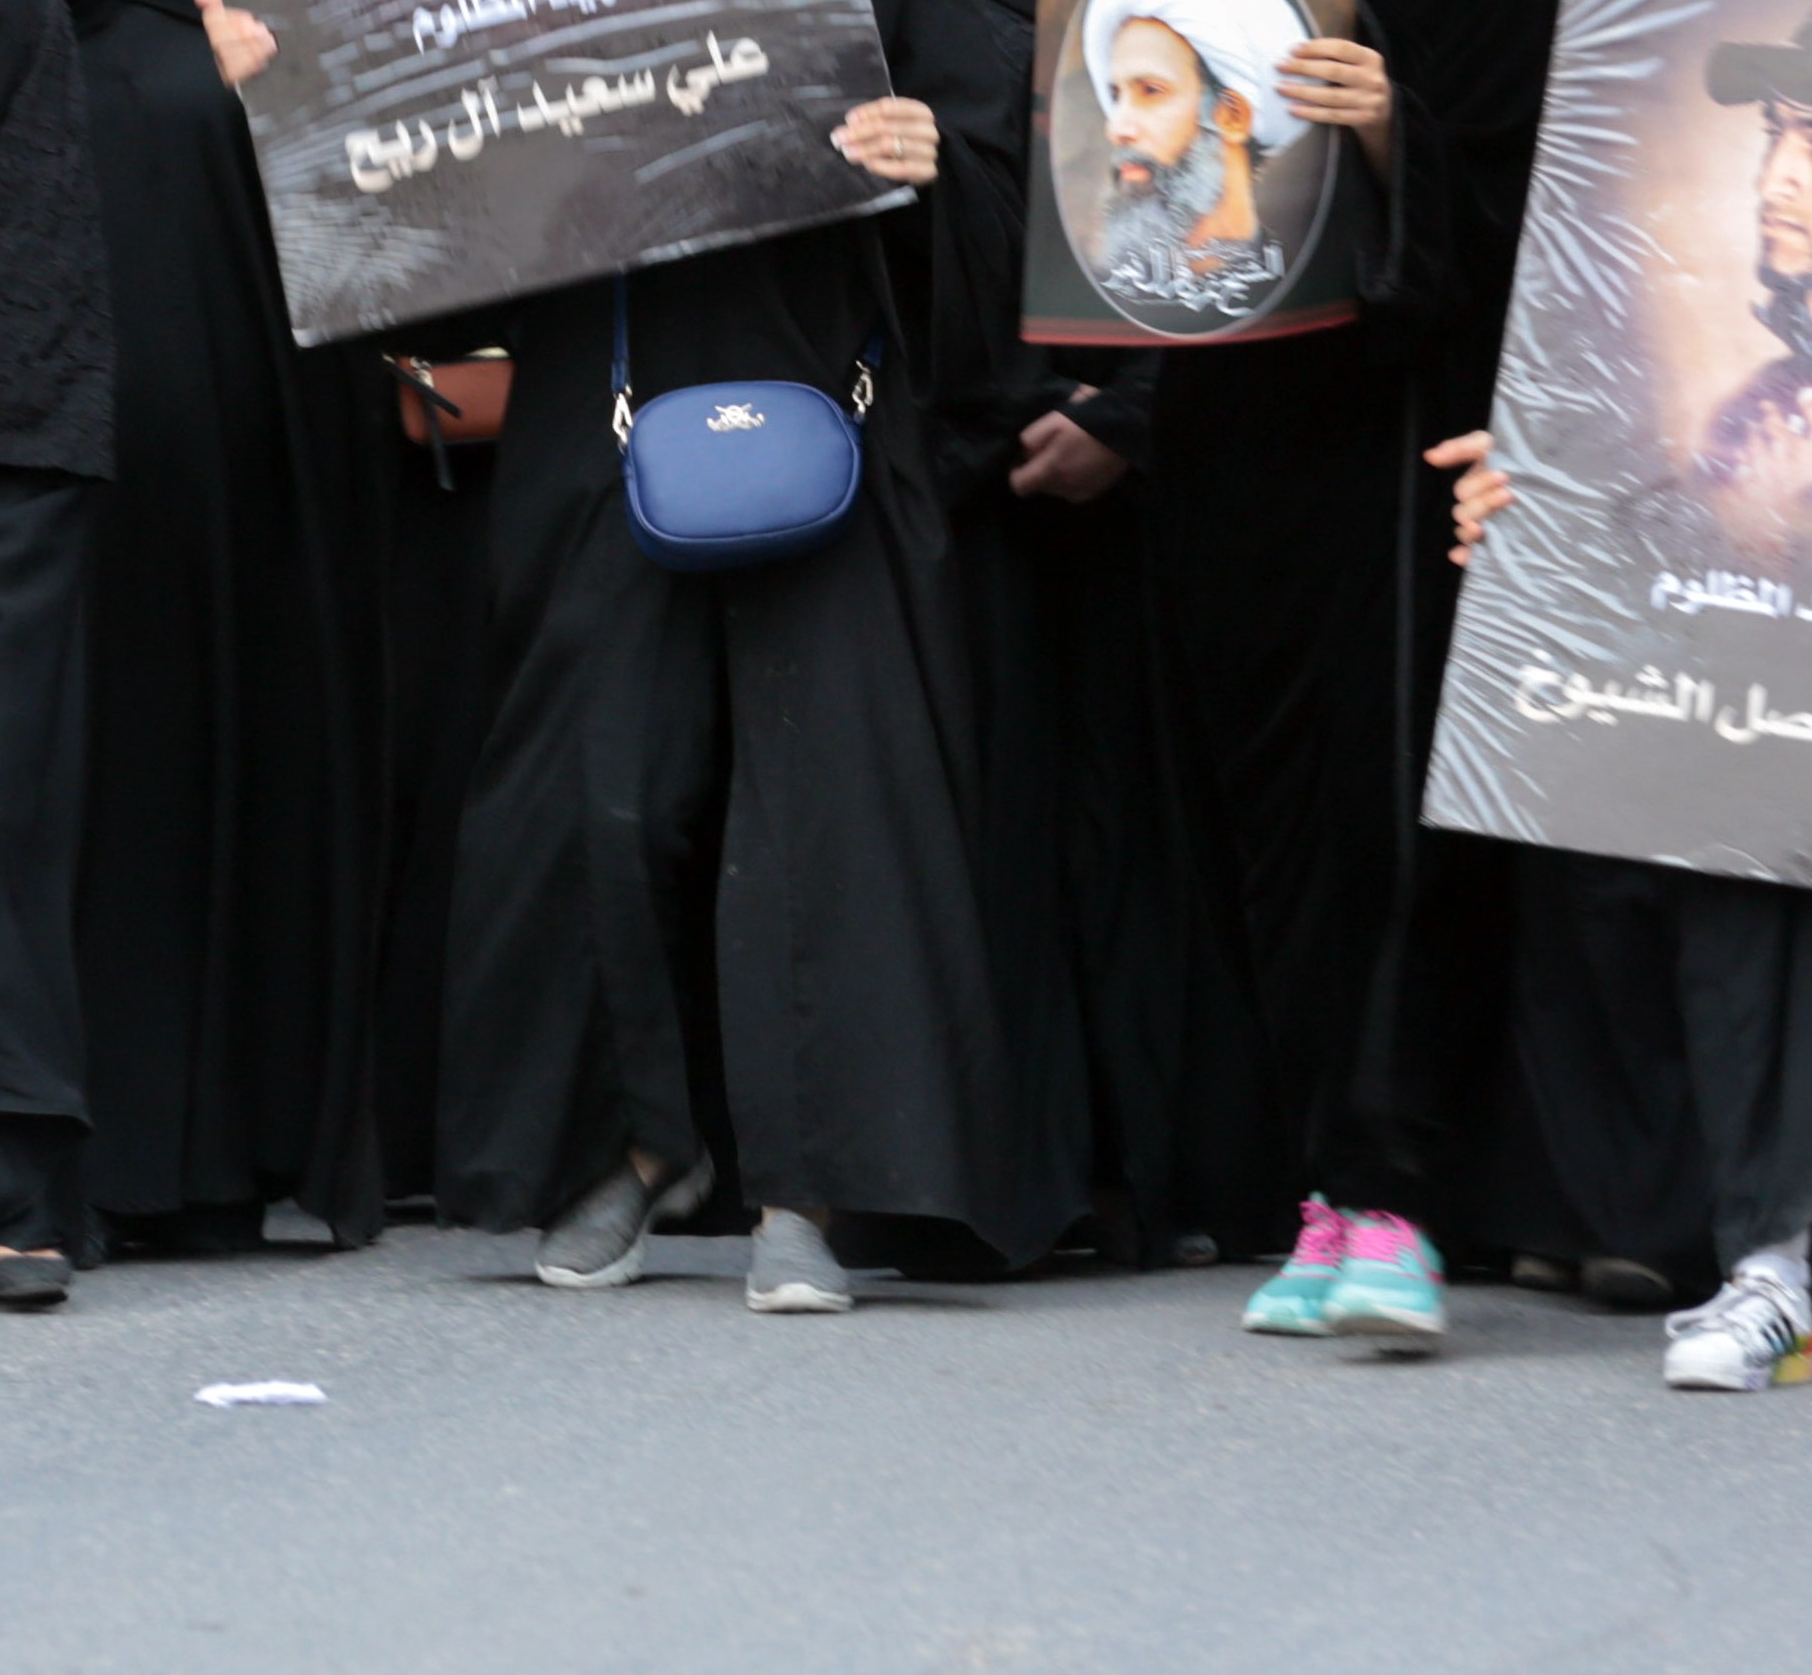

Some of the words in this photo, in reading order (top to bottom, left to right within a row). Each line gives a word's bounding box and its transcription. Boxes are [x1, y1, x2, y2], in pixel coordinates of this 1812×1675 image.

[517, 67, 657, 138] سعيد
[666, 29, 769, 118] علي
[447, 75, 501, 161] آل
[1648, 569, 1793, 618] المظلوم
[1515, 648, 1715, 727] الشيوخ
